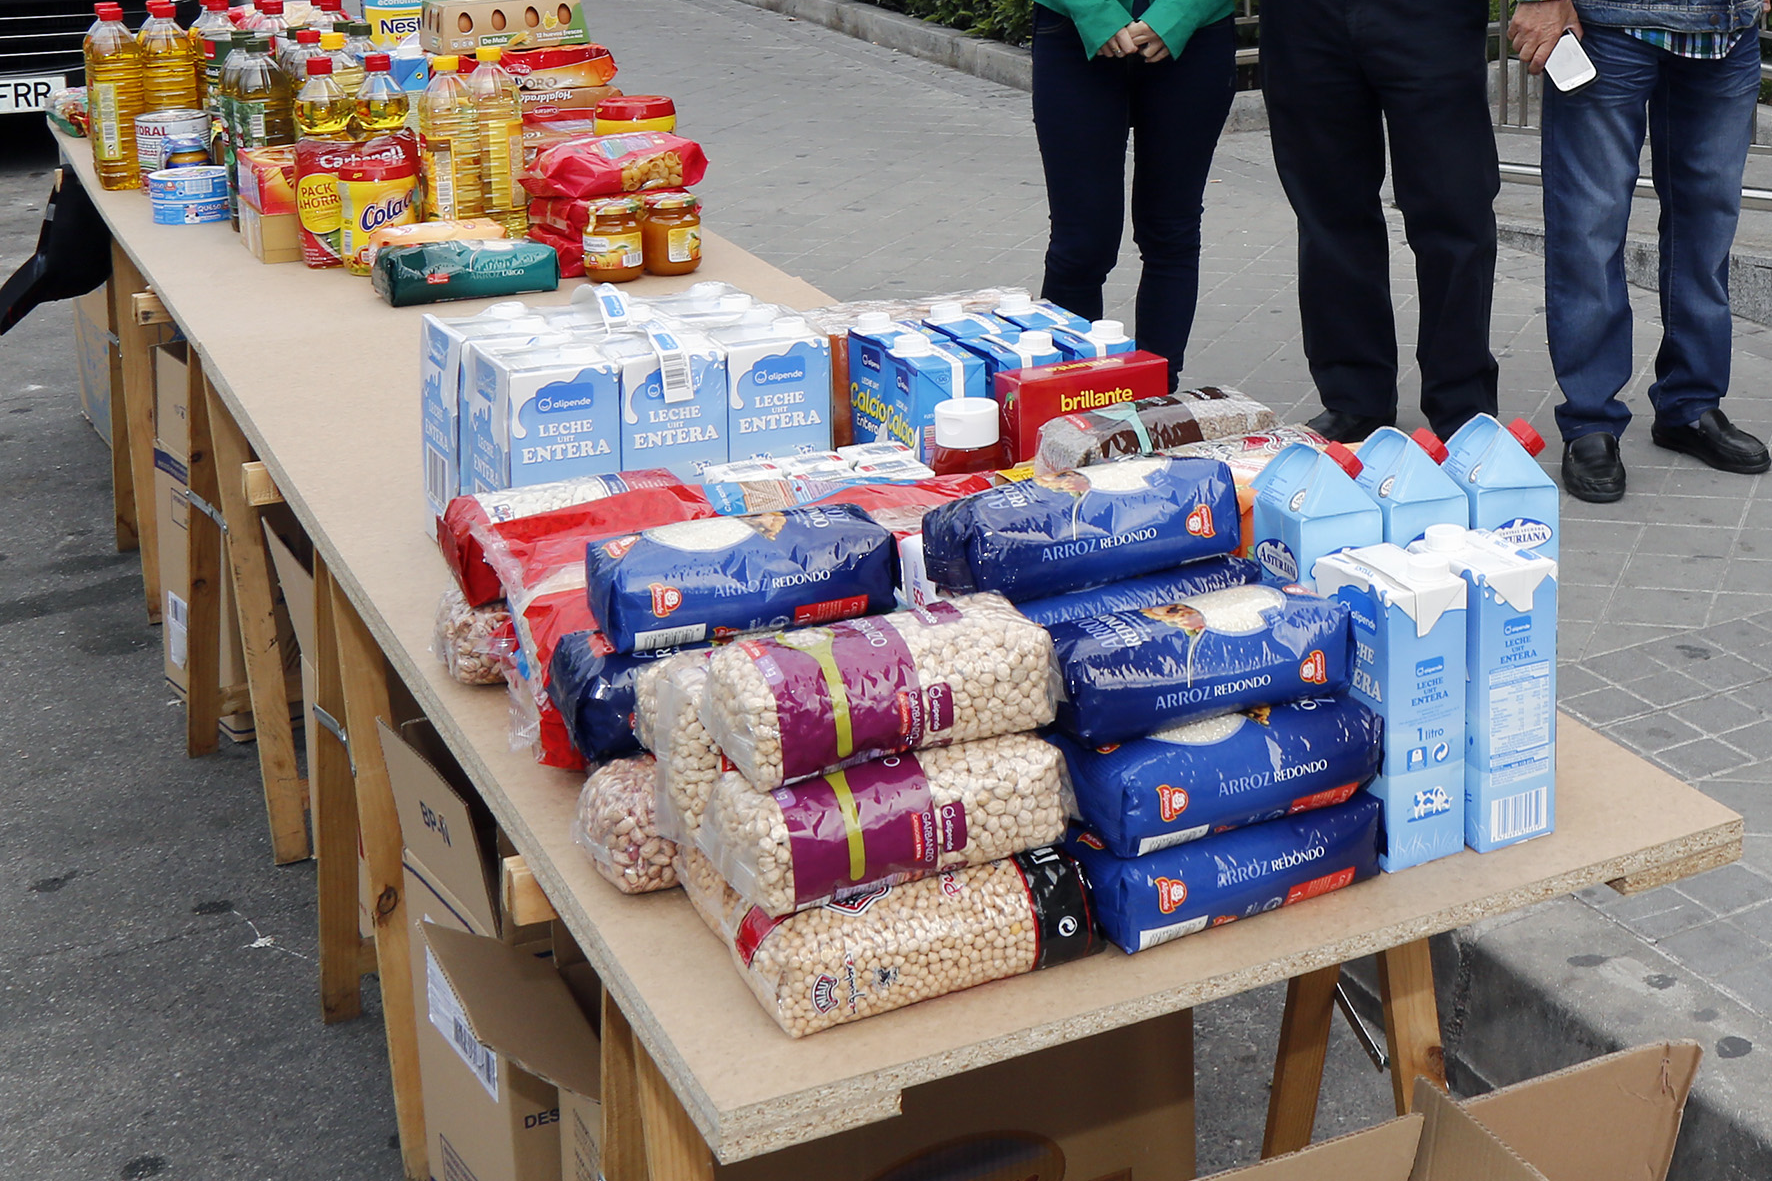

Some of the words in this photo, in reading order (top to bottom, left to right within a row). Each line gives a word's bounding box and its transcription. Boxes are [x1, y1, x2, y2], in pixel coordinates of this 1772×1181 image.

[381, 17, 421, 35] Nest
[543, 30, 563, 38] huevos
[563, 28, 583, 37] frescos
[300, 193, 342, 209] AHORR
[301, 182, 334, 198] PACK
[501, 267, 525, 277] LARGO
[768, 369, 803, 381] alipende
[552, 396, 592, 409] alipende
[754, 390, 805, 409] LECHE
[771, 405, 789, 413] UHT
[850, 381, 887, 422] Calcio
[1060, 386, 1134, 412] brillante
[648, 405, 702, 424] LECHE
[667, 420, 685, 429] UHT
[739, 409, 822, 434] ENTERA
[887, 404, 915, 448] Calcio
[425, 418, 449, 453] ENTERA
[538, 419, 594, 438] LECHE
[557, 434, 575, 443] UHT
[633, 424, 719, 450] ENTERA
[477, 433, 495, 457] LECHE
[521, 438, 612, 464] ENTERA
[473, 453, 500, 486] ENTERA
[1041, 538, 1098, 563] ARROZ
[1099, 527, 1158, 551] REDONDO
[1260, 546, 1297, 580] ASTURIANA
[713, 579, 770, 598] ARROZ
[771, 569, 831, 589] REDONDO
[1351, 609, 1377, 631] alipende
[1505, 635, 1532, 648] LECHE
[1500, 649, 1538, 665] ENTERA
[1154, 685, 1212, 711] ARROZ
[1213, 674, 1272, 698] REDONDO
[1352, 668, 1383, 703] ERA
[1416, 676, 1444, 691] LECHE
[1423, 687, 1438, 695] UHT
[1411, 689, 1449, 707] ENTERA
[908, 691, 921, 739] GARBANZO
[932, 699, 941, 730] alipende
[1417, 727, 1423, 741] 1
[1425, 726, 1445, 741] litro
[1217, 770, 1273, 798] ARROZ
[1273, 758, 1328, 783] REDONDO
[1161, 787, 1171, 819] Alipende
[922, 811, 935, 863] GARBANZO
[945, 819, 954, 851] alipende
[1216, 861, 1271, 889] ARROZ
[1270, 845, 1325, 872] REDONDO
[1160, 879, 1170, 911] Alipende
